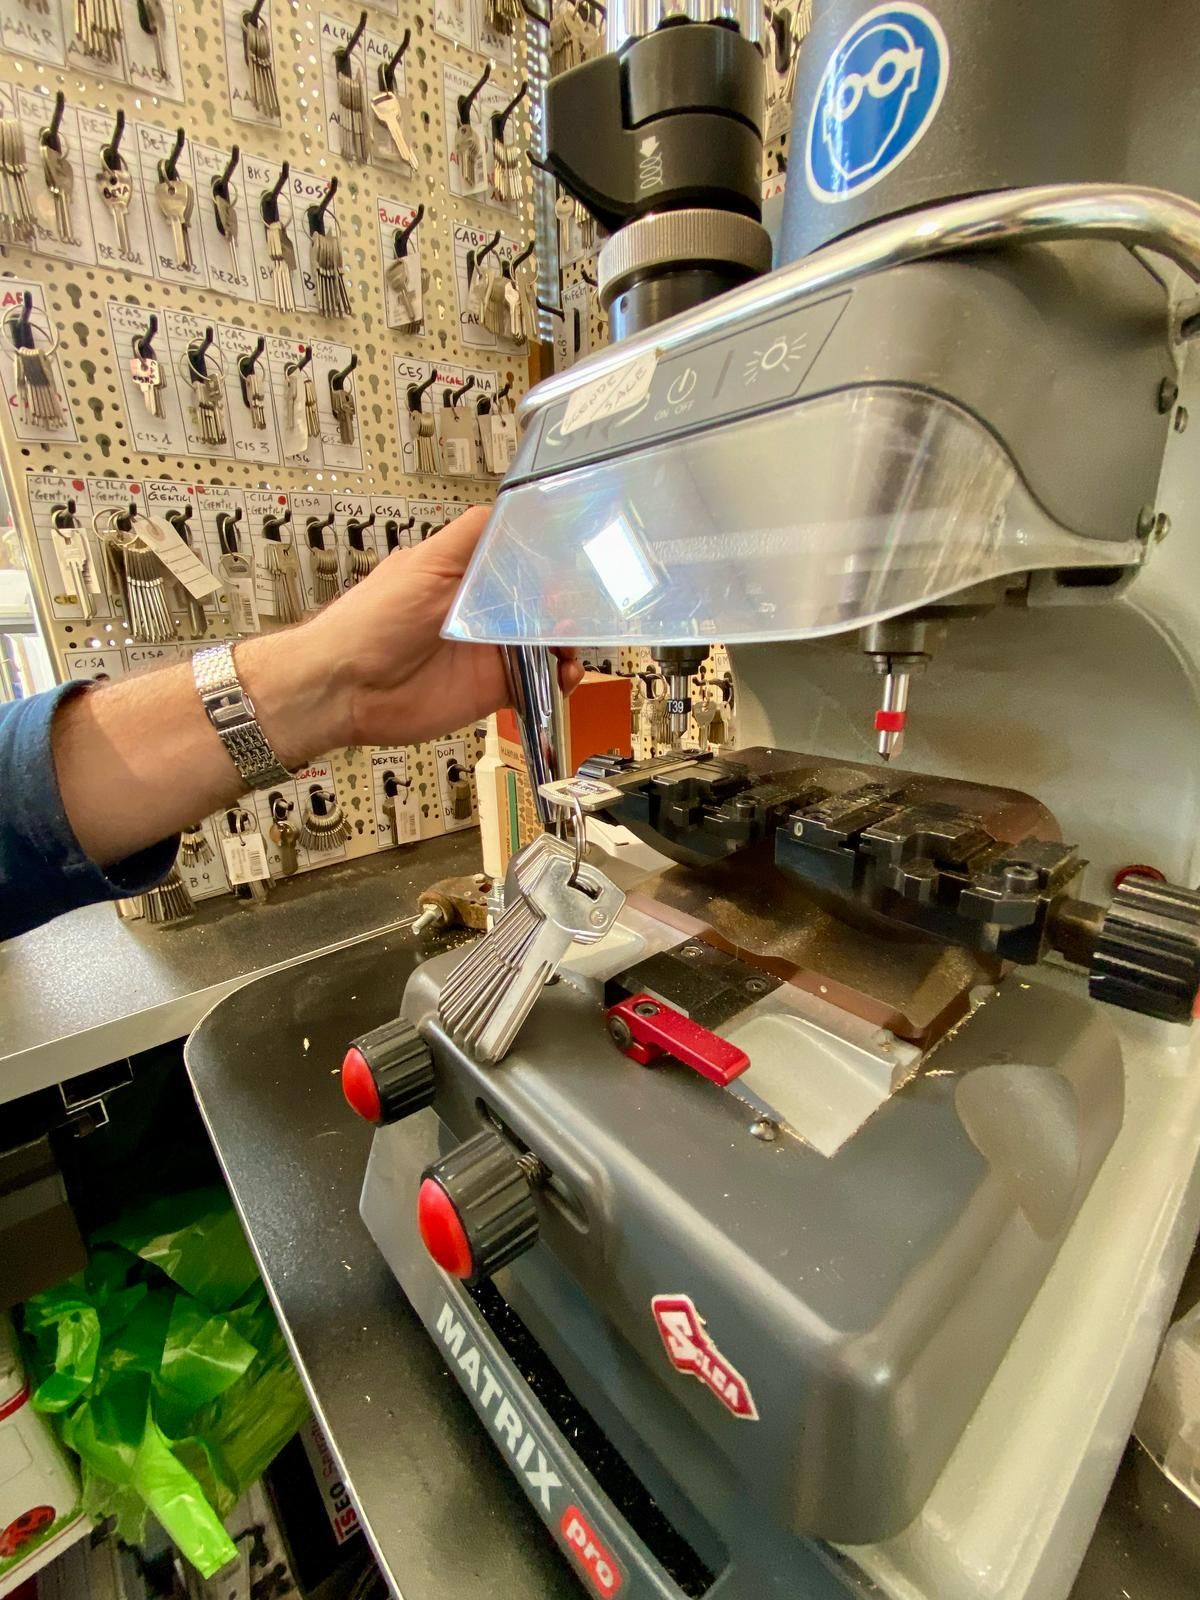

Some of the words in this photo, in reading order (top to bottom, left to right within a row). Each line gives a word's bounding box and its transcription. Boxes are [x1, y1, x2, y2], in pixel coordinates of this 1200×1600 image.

[323, 23, 361, 49] ALPH
[367, 38, 403, 65] ALPH
[668, 700, 684, 713] T39
[436, 1302, 563, 1512] MATRIX
[565, 1518, 615, 1590] pro
